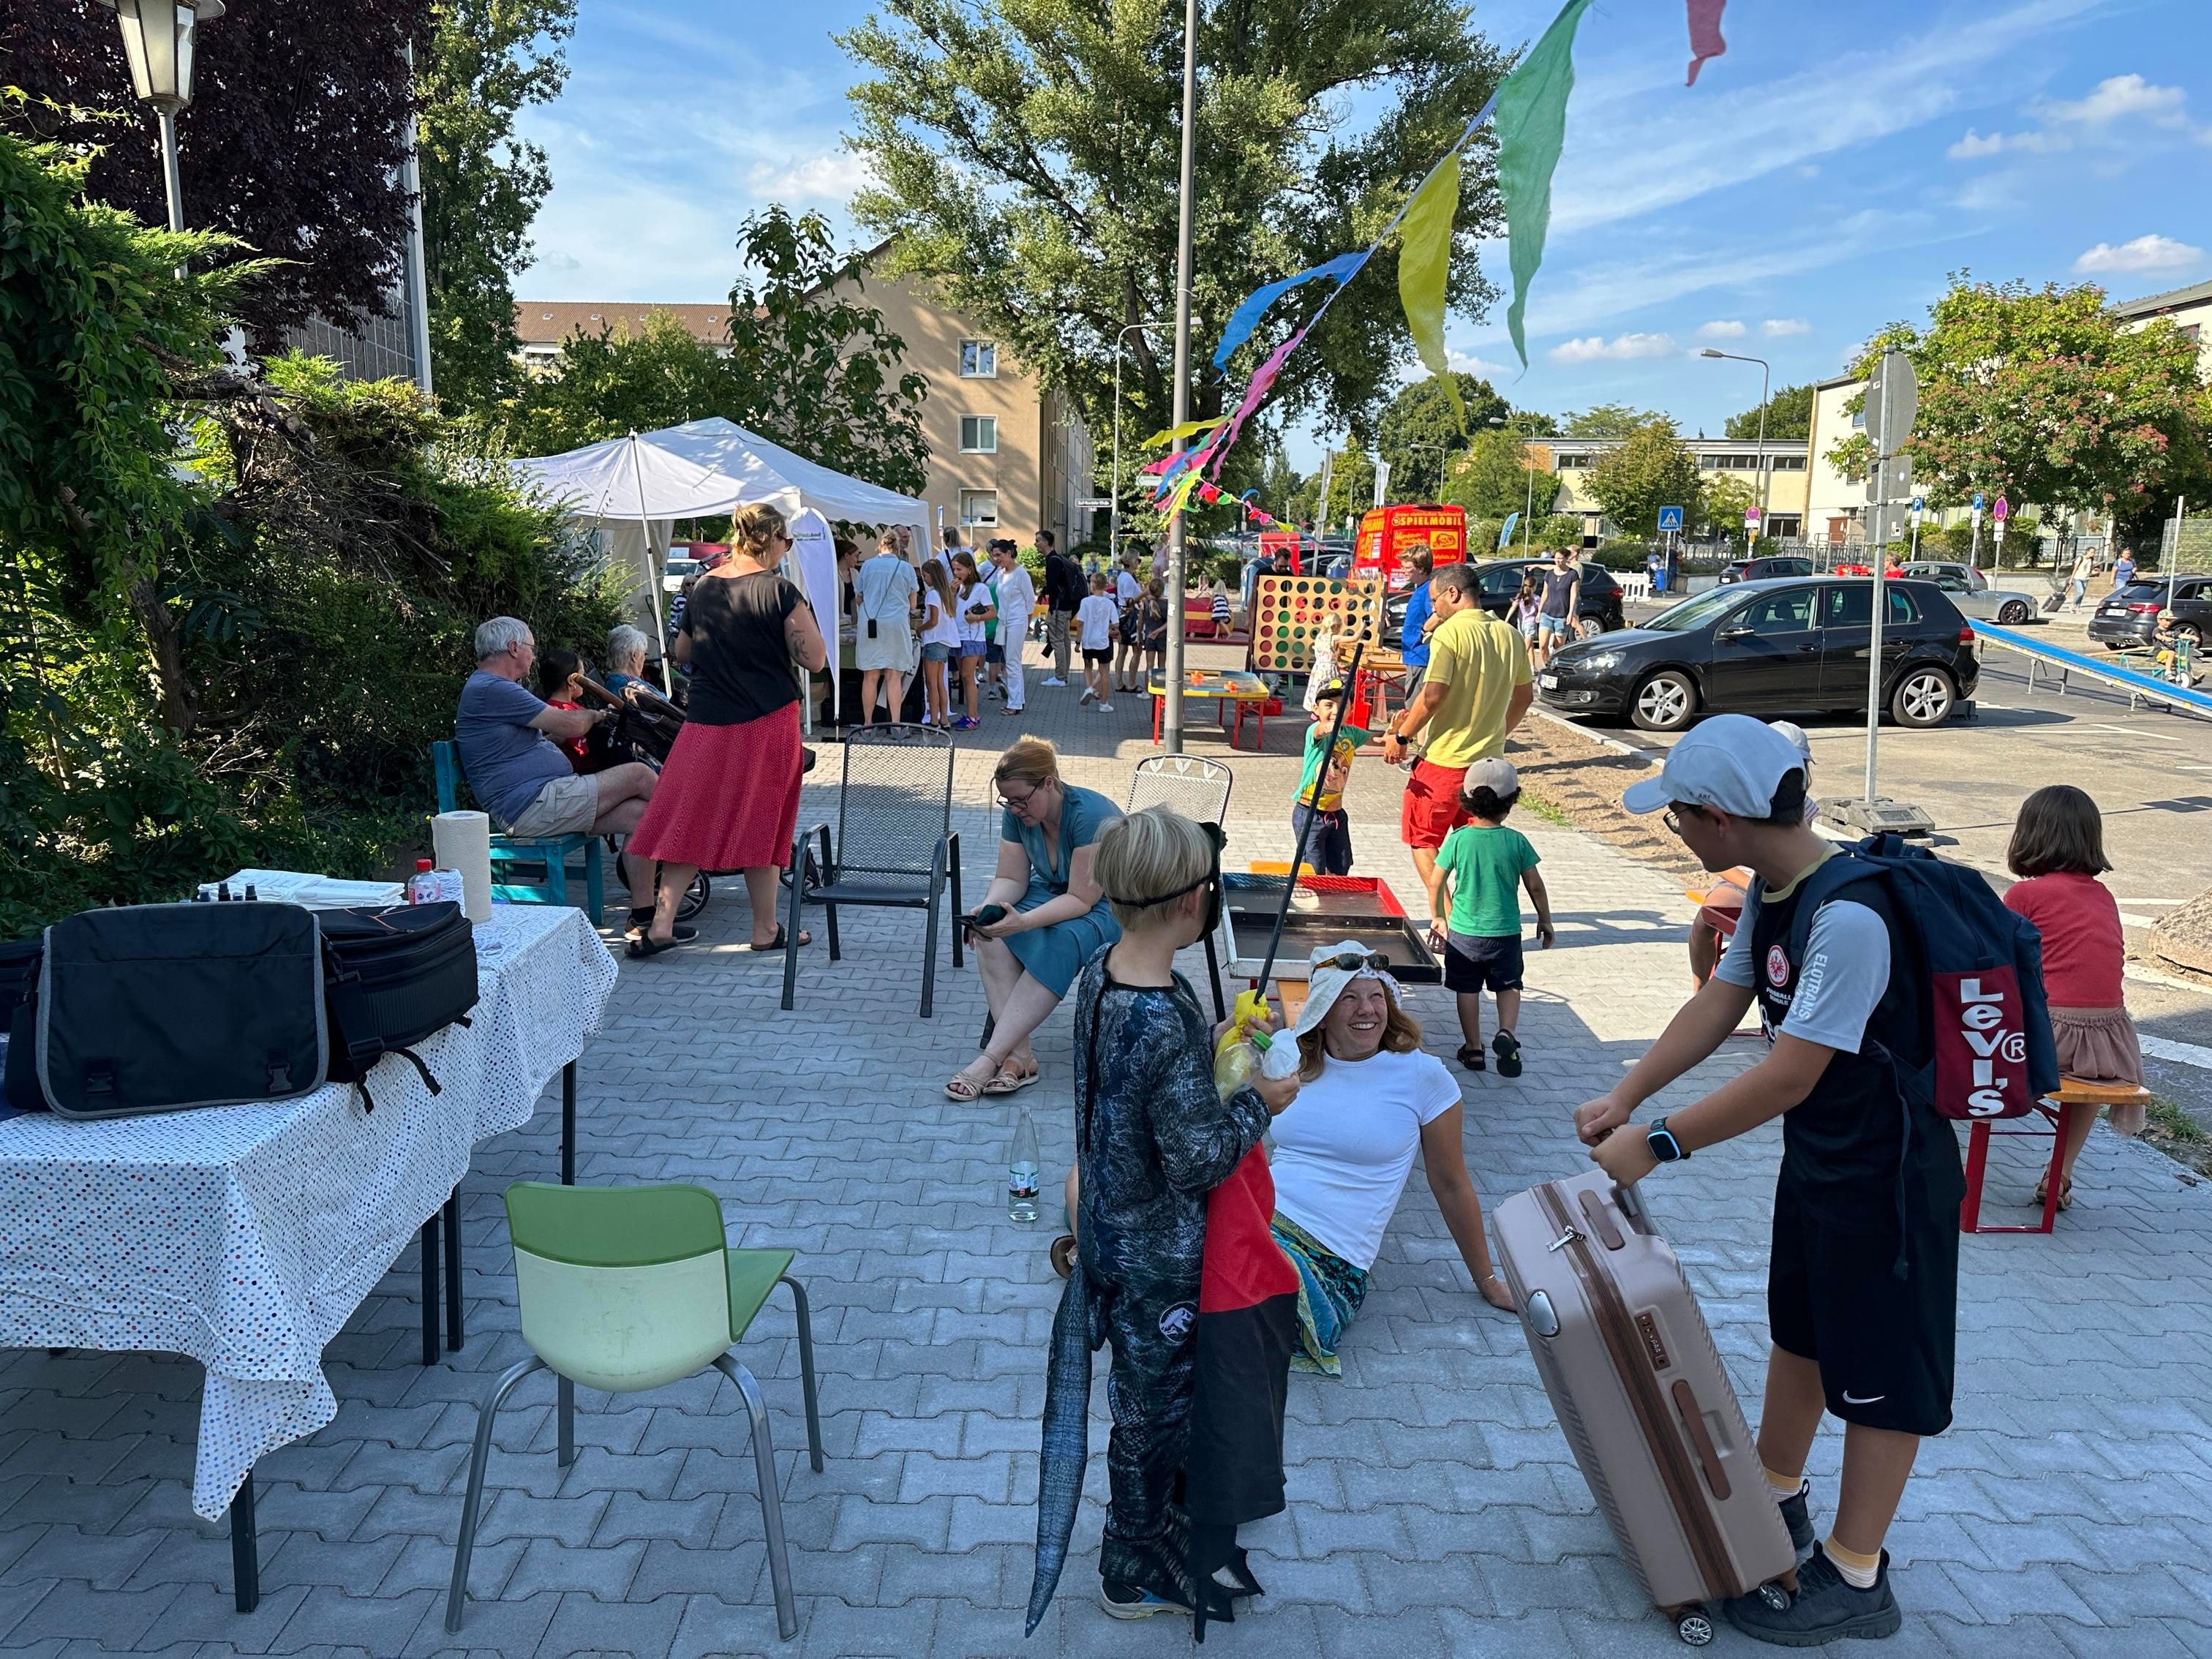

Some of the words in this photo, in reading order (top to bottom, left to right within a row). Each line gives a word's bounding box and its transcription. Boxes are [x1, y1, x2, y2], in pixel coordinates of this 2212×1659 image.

[1914, 498, 1920, 510] P
[1975, 495, 1981, 508] P
[1400, 516, 1462, 526] SPIELMOBIL
[1798, 953, 1829, 1020] ELOTRANS
